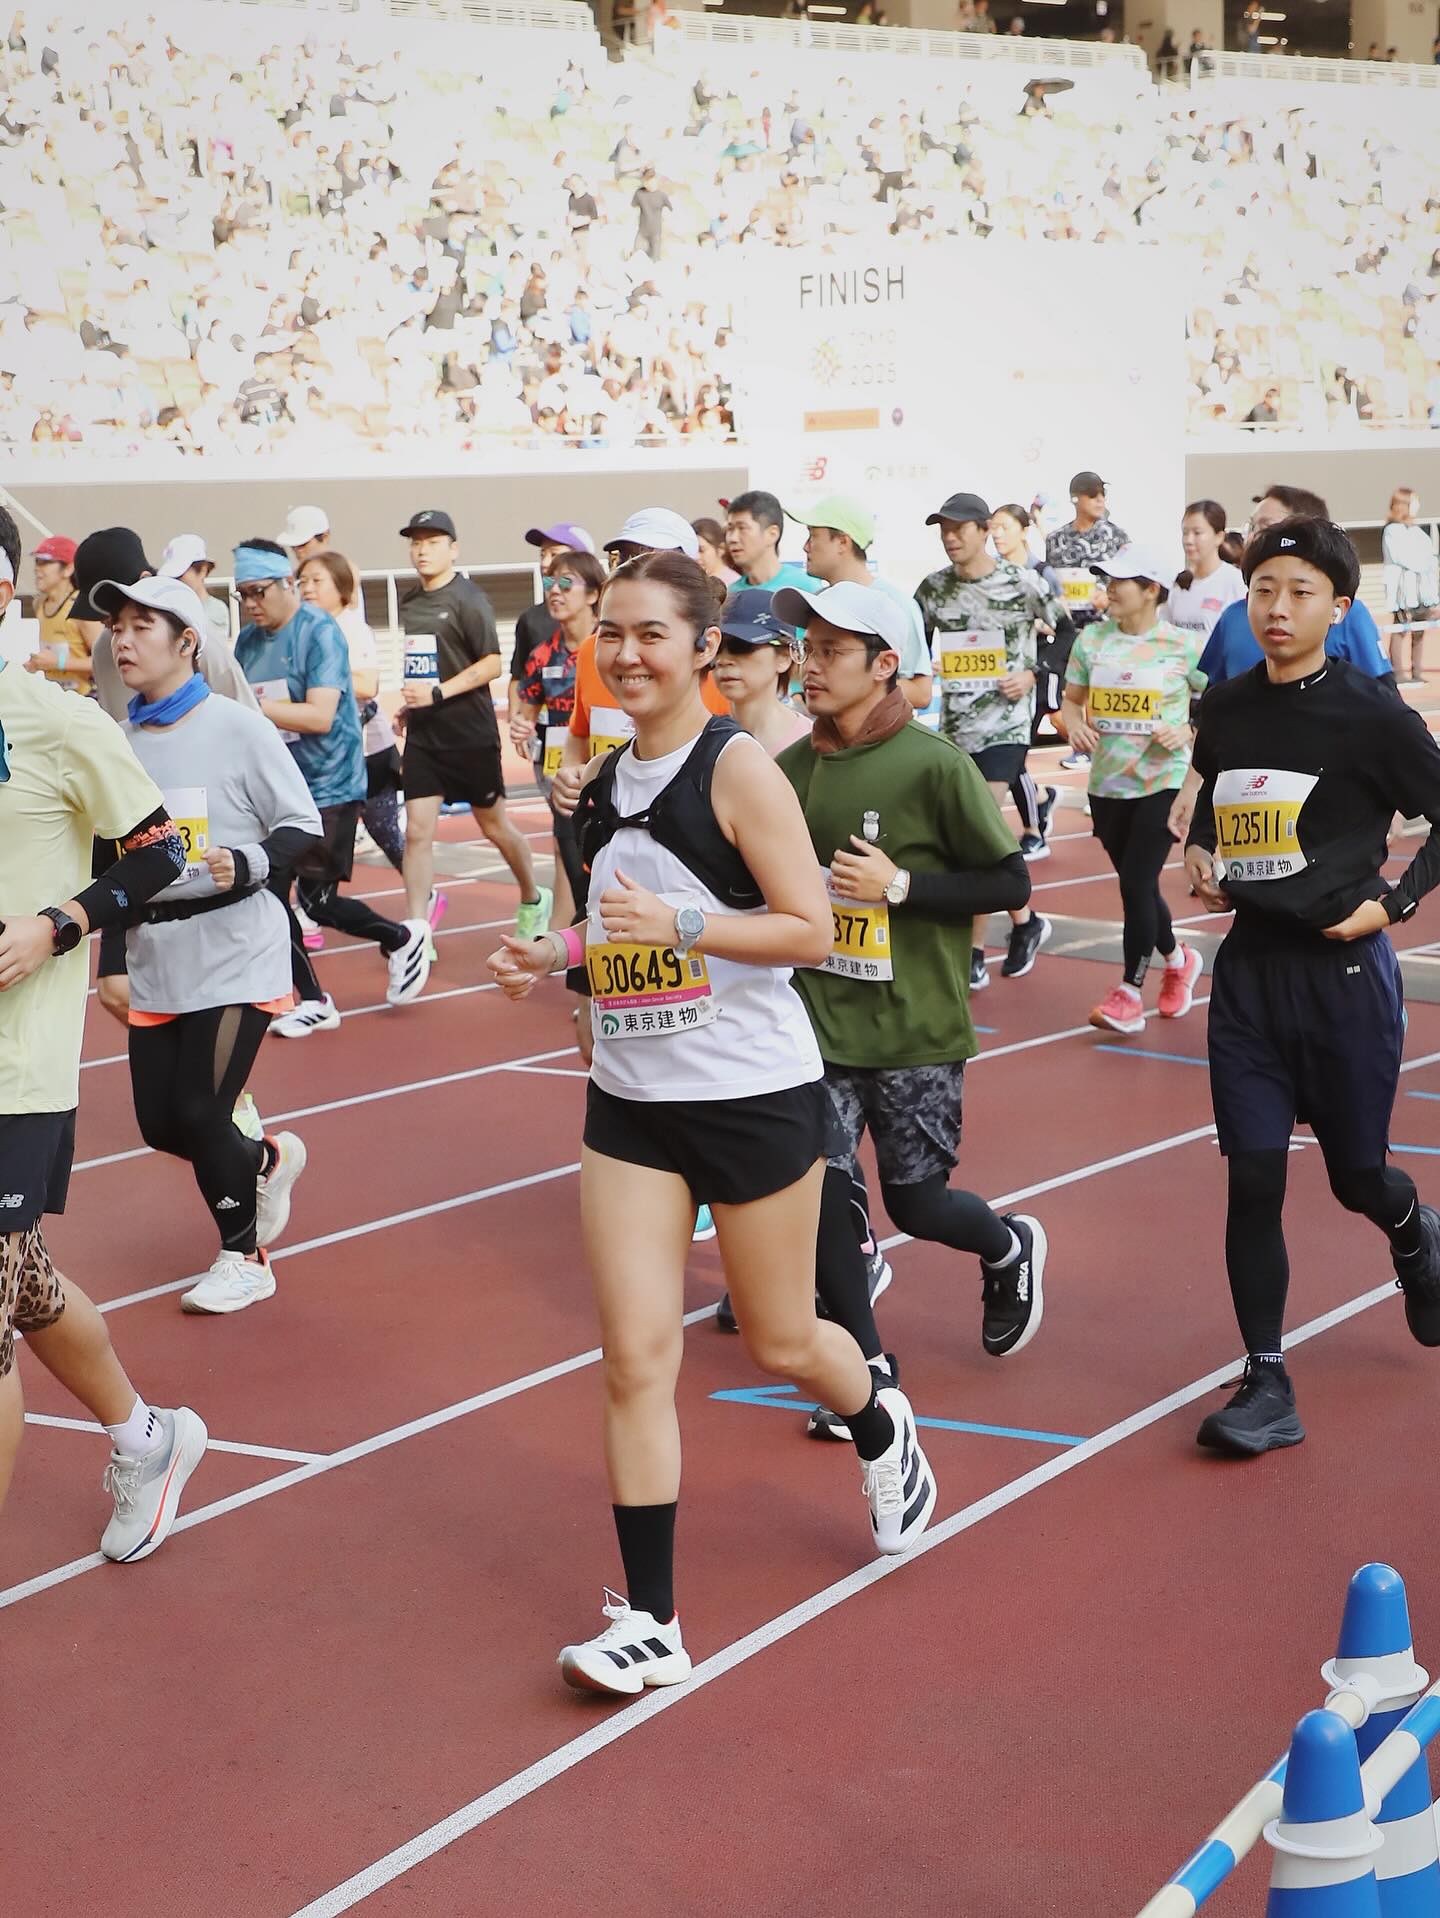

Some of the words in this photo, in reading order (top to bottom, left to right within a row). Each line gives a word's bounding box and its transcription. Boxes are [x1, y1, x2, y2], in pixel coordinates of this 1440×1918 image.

[799, 265, 904, 309] FINISH
[943, 654, 996, 673] L23399
[1092, 693, 1149, 713] L32524
[1219, 810, 1280, 846] L23511
[1246, 859, 1292, 876] 東京建物
[589, 948, 682, 995] L30649
[623, 1007, 698, 1031] 東京建物
